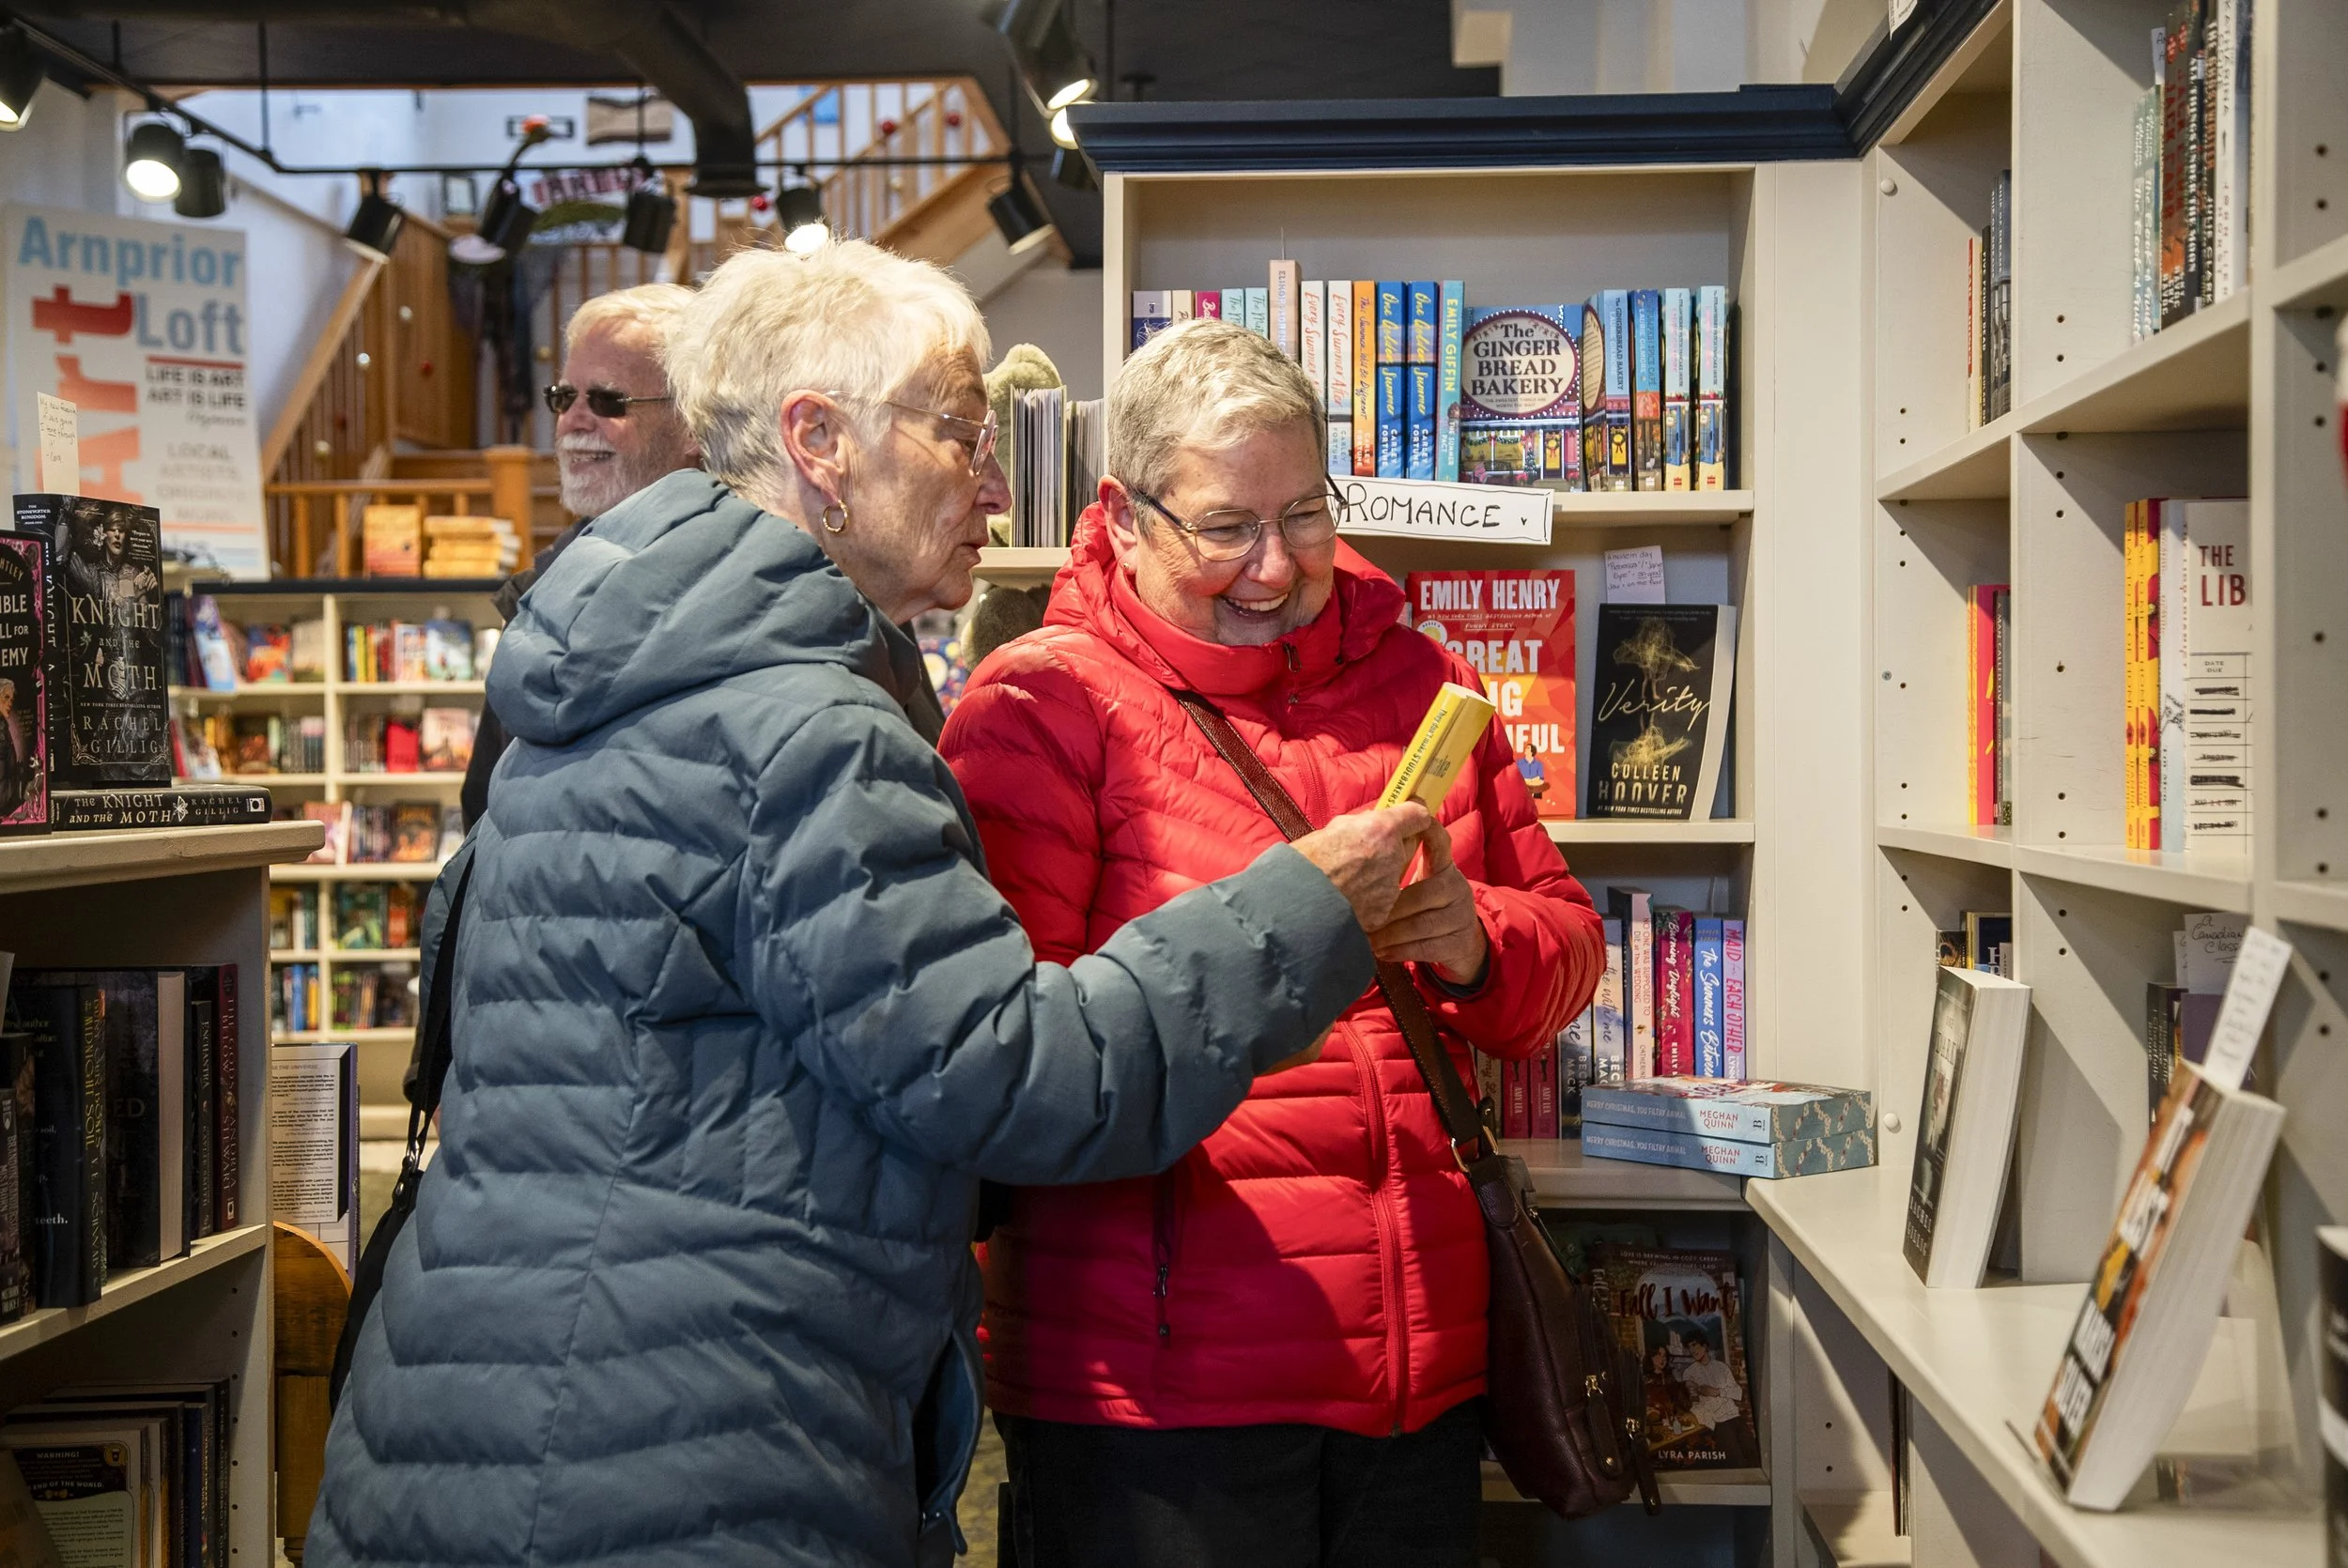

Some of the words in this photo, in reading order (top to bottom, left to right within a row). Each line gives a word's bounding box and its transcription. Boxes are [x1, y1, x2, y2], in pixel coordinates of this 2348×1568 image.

[17, 215, 245, 287] Arnprior
[1304, 292, 1320, 327] Every
[1332, 293, 1348, 328] Every
[1382, 292, 1399, 315] One
[1414, 292, 1432, 315] One
[135, 292, 246, 356] Loft
[1446, 299, 1458, 340] EMILY
[1501, 323, 1535, 339] The
[1304, 328, 1321, 374] Summer
[1332, 330, 1349, 377] Summer
[1381, 319, 1398, 364] Golden
[1413, 319, 1431, 364] Golden
[1473, 339, 1561, 358] GINGER
[146, 367, 184, 384] LIFE
[1444, 344, 1457, 392] GIFFIN
[1477, 359, 1557, 377] BREAD
[208, 391, 247, 408] LIFE
[1332, 379, 1348, 408] After
[1381, 367, 1397, 416] Summer
[1413, 367, 1429, 415] Summer
[1471, 377, 1564, 396] BAKERY
[1346, 484, 1501, 529] ROMANCE
[1639, 550, 1653, 561] day
[2199, 545, 2234, 567] THE
[1420, 579, 1483, 610] EMILY
[1492, 578, 1560, 610] HENRY
[71, 593, 160, 630] KNIGHT
[15, 625, 29, 636] FOR
[1599, 680, 1714, 731] Verity
[83, 715, 162, 731] RACHEL
[90, 740, 158, 755] GILLIG
[1388, 753, 1421, 805] STUDEBAKERS
[1612, 762, 1681, 782] COLLEEN
[74, 798, 95, 807] THE
[103, 792, 164, 808] KNIGHT
[191, 797, 242, 807] RACHEL
[1598, 780, 1688, 805] HOOVER
[70, 813, 90, 823] AND
[94, 813, 114, 822] THE
[120, 809, 172, 823] MOTH
[195, 807, 239, 816] GILLIG
[1664, 921, 1679, 965] Burning
[1700, 947, 1718, 967] The
[1725, 928, 1742, 962] MAID
[1600, 989, 1617, 1014] with
[1665, 969, 1680, 1019] Daylight
[1699, 970, 1721, 1025] Summers
[1726, 977, 1743, 1012] EACH
[221, 1014, 229, 1073] BELOW
[1602, 1022, 1613, 1044] me
[1726, 1013, 1743, 1053] OTHER
[84, 1016, 95, 1097] MIDNIGHT
[201, 1021, 210, 1090] ENCHANTRA
[226, 1038, 236, 1090] GODS
[1567, 1058, 1576, 1094] MACK
[1514, 1086, 1522, 1100] AMY
[1514, 1102, 1522, 1114] LEA
[1542, 1086, 1551, 1100] AMY
[1542, 1102, 1551, 1114] LEA
[1585, 1099, 1604, 1110] MERRY
[1648, 1107, 1665, 1117] FILTHY
[1665, 1109, 1687, 1119] ANIMAL
[1699, 1110, 1738, 1121] MEGHAN
[85, 1104, 95, 1151] SOIL
[1704, 1119, 1735, 1130] QUINN
[7, 1135, 18, 1178] BRANDON
[222, 1115, 230, 1191] STEWART
[228, 1115, 237, 1187] ANDREA
[1585, 1135, 1604, 1145] MERRY
[1648, 1143, 1665, 1153] FILTHY
[1665, 1145, 1687, 1155] ANIMAL
[1701, 1145, 1740, 1157] MEGHAN
[1706, 1154, 1736, 1165] QUINN
[8, 1179, 19, 1237] SANDERSON
[1619, 1283, 1657, 1320] Fall
[1663, 1286, 1673, 1317] I
[1681, 1282, 1737, 1319] Want
[1659, 1450, 1684, 1459] LYRA
[1688, 1451, 1726, 1460] PARISH
